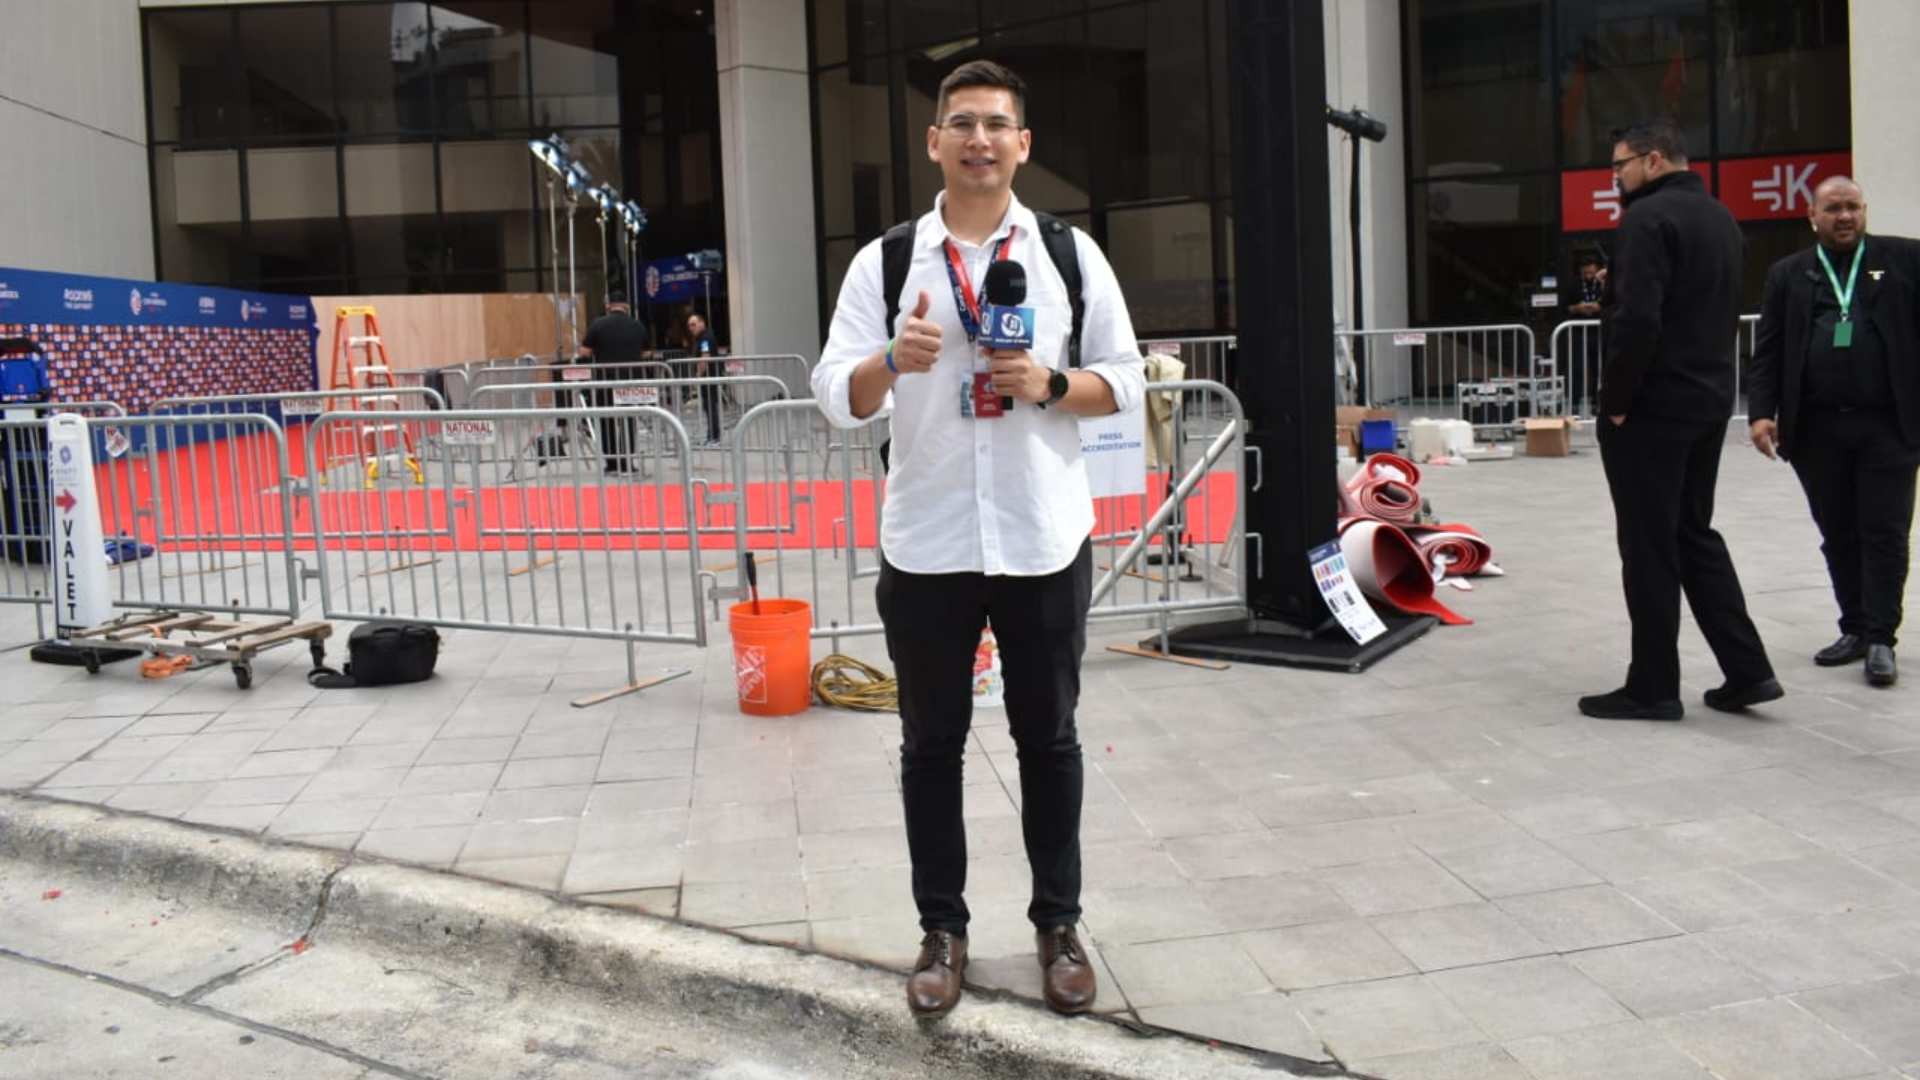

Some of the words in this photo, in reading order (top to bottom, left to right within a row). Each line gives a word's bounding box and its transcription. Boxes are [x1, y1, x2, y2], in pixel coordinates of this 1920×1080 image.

[447, 421, 492, 433] NATIONAL
[1098, 432, 1122, 441] PRESS
[1081, 442, 1141, 452] ACCREDITATION
[62, 519, 76, 621] VALET
